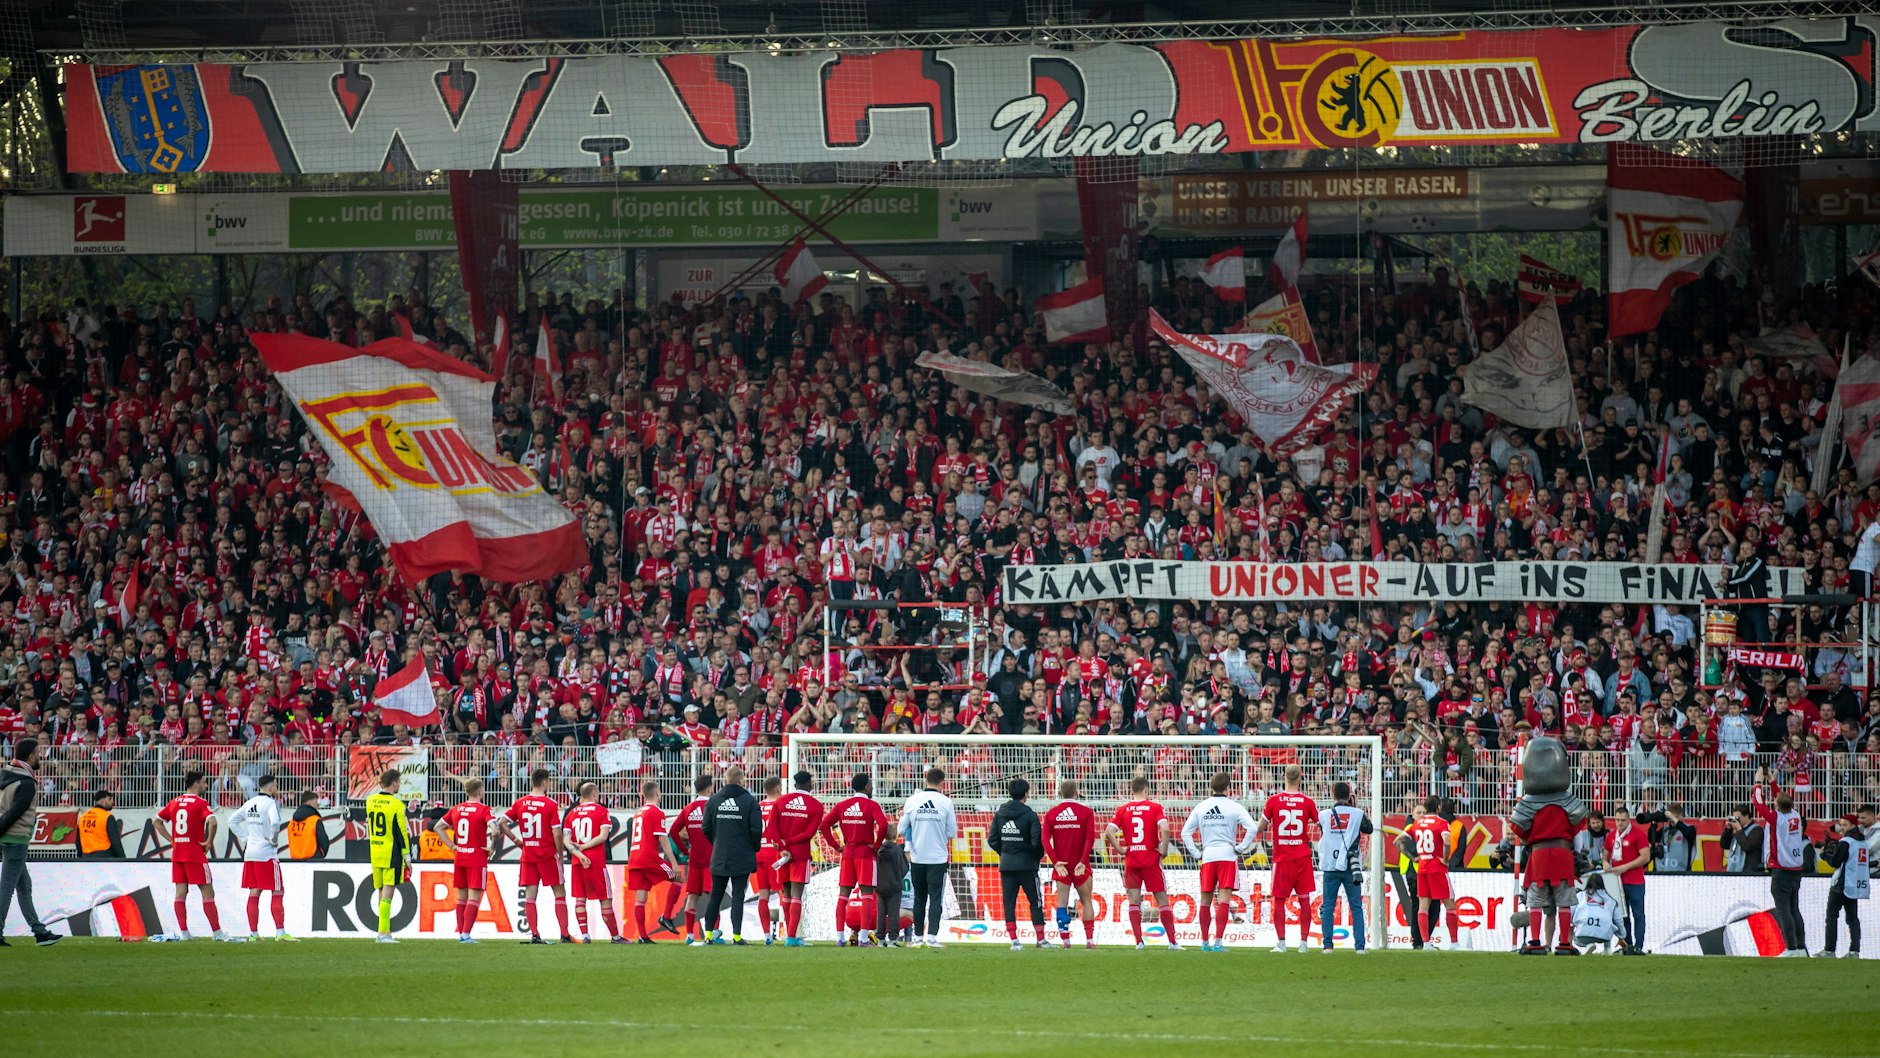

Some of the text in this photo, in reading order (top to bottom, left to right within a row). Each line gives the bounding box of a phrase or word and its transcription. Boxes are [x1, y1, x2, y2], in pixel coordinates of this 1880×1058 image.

[1403, 60, 1553, 132] UNION
[1573, 78, 1823, 144] Berlin
[992, 94, 1229, 160] Union
[1177, 175, 1462, 200] UNSER VEREIN, UNSER RASEN,
[391, 200, 454, 223] niema
[518, 200, 603, 225] gessen,
[611, 197, 710, 222] Köpenick
[717, 196, 744, 217] ist
[752, 197, 812, 216] unser
[819, 194, 920, 215] Zuhause!
[959, 199, 992, 213] bwv
[1177, 207, 1240, 226] UNSER
[215, 215, 247, 228] bwv
[415, 229, 444, 241] BWV
[691, 224, 713, 238] Tel.
[718, 226, 742, 238] 030
[756, 226, 769, 238] 72
[687, 268, 714, 282] ZUR
[1006, 561, 1183, 601] KÄMPFT
[82, 819, 96, 829] 184
[175, 808, 188, 835] 8
[291, 822, 306, 832] 217
[369, 812, 387, 837] 19
[457, 818, 469, 844] 9
[522, 812, 542, 838] 31
[571, 817, 593, 843] 10
[1131, 817, 1144, 843] 3
[1278, 809, 1304, 836] 25
[425, 837, 443, 847] 176
[1415, 829, 1435, 854] 28
[1857, 880, 1868, 889] 05
[311, 871, 532, 933] ROPA GMB
[1587, 917, 1601, 927] 01
